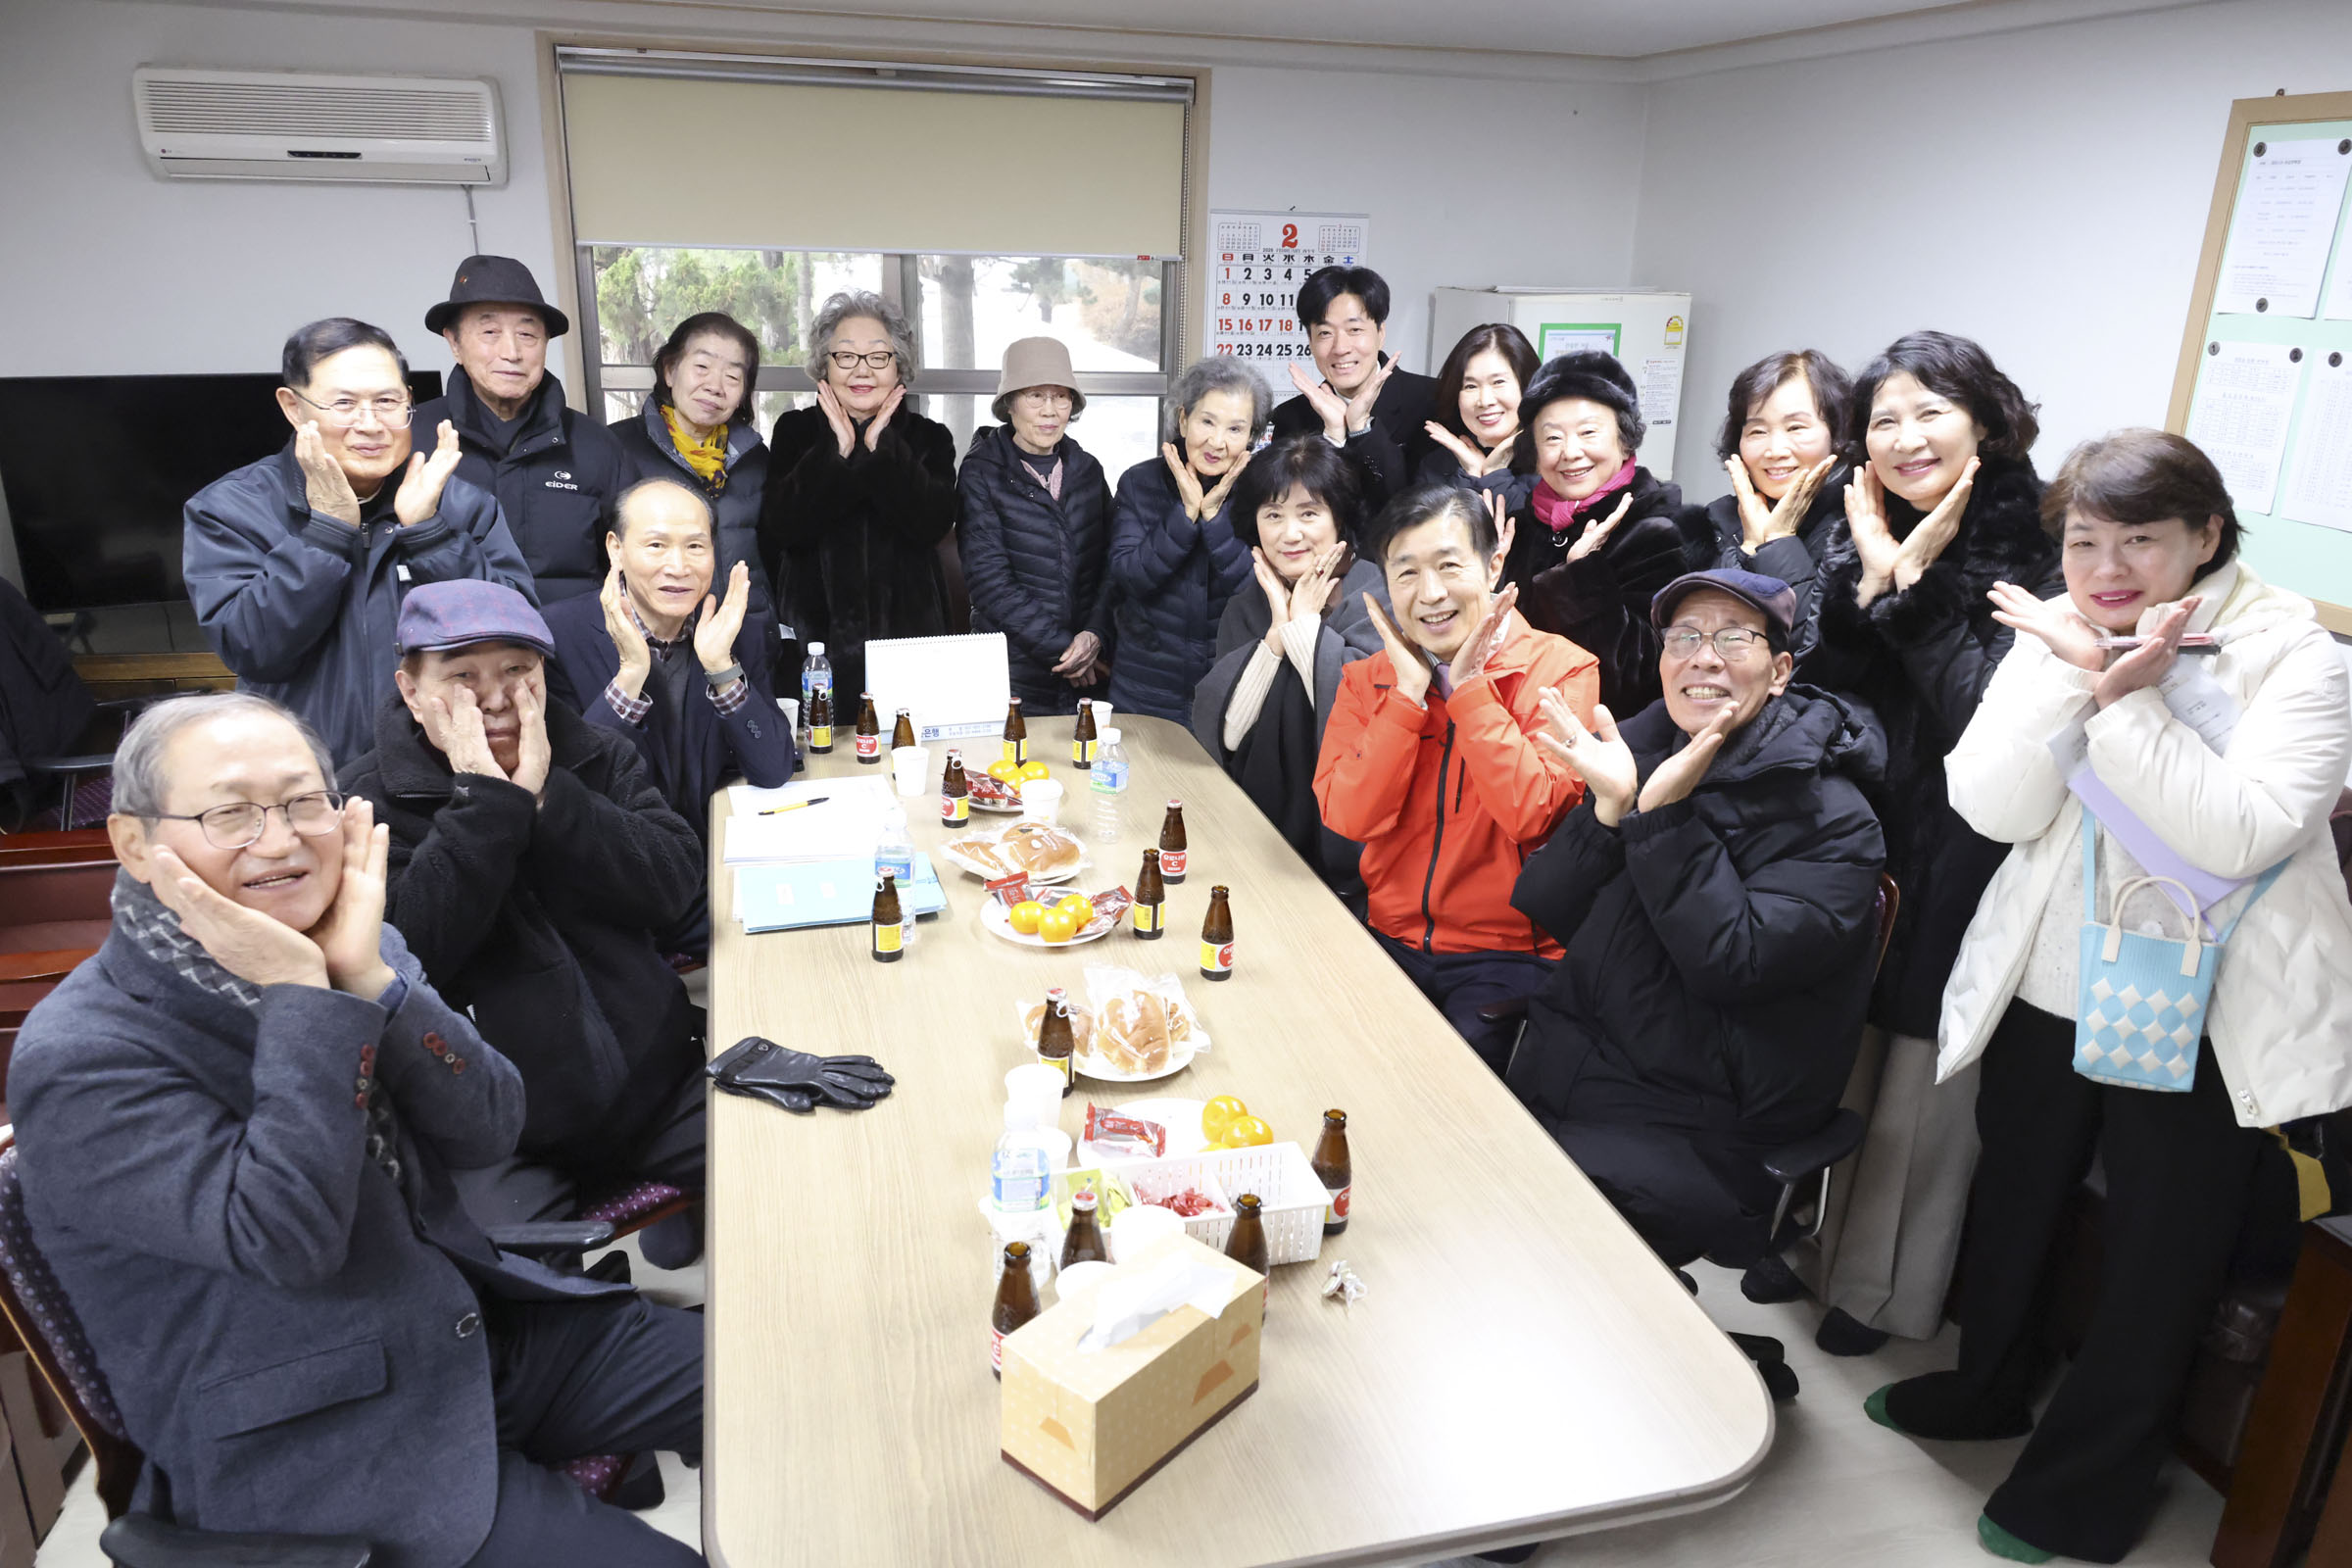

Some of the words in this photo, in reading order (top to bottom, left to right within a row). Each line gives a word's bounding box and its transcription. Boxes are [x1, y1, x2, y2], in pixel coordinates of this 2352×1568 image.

[1282, 223, 1298, 248] 2
[1243, 253, 1253, 262] 月
[1283, 254, 1295, 263] 水
[1323, 255, 1335, 264] 金
[1225, 267, 1230, 279] 1
[1244, 268, 1251, 279] 2
[1264, 268, 1272, 280] 3
[1284, 269, 1292, 281] 4
[1304, 269, 1311, 280] 5
[1222, 293, 1231, 305] 8
[1243, 293, 1250, 305] 9
[1259, 293, 1274, 306] 10
[1280, 294, 1295, 306] 11
[1218, 318, 1233, 331] 15
[1239, 318, 1253, 331] 16
[1258, 318, 1273, 331] 17
[1278, 319, 1293, 331] 18
[1216, 343, 1233, 355] 22
[1237, 343, 1252, 356] 23
[1256, 344, 1272, 356] 24
[1276, 344, 1293, 356] 25
[1297, 344, 1311, 356] 26
